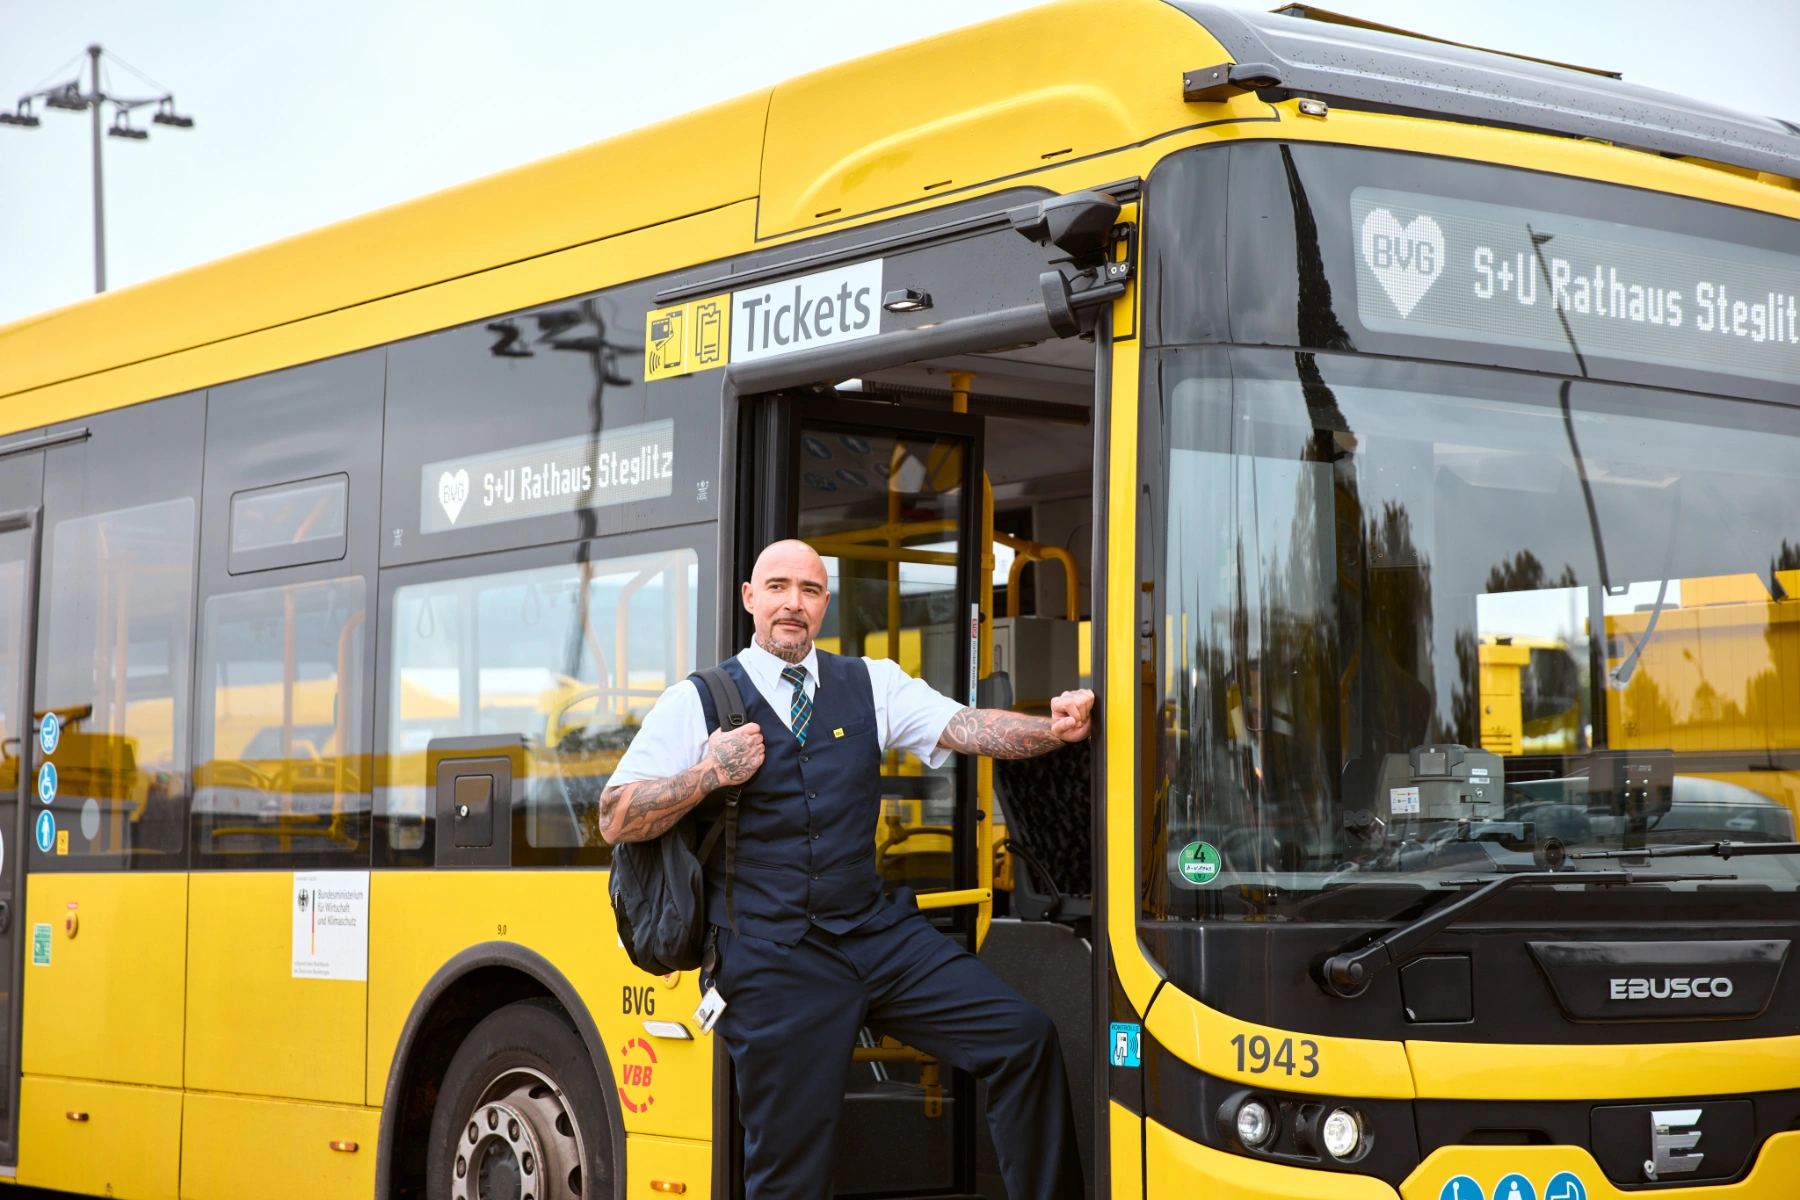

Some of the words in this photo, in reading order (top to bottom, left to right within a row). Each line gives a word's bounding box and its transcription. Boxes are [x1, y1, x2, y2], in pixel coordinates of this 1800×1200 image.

[1372, 233, 1434, 276] BVG
[1474, 246, 1536, 306] S+U
[1552, 258, 1682, 327] Rathaus
[1696, 281, 1799, 344] Steglit
[742, 281, 870, 352] Tickets
[483, 469, 515, 507] S+U
[521, 461, 592, 501] Rathaus
[598, 444, 673, 488] Steglitz
[443, 482, 465, 504] BVG
[1194, 844, 1205, 862] 4
[317, 889, 364, 900] Bundesministerium
[325, 902, 350, 913] Wirtschaft
[317, 916, 327, 926] und
[328, 916, 357, 927] Klimaschutz
[622, 985, 655, 1016] BVG
[1610, 977, 1734, 1000] EBUSCO
[1230, 1033, 1320, 1078] 1943
[622, 1063, 653, 1087] VBB
